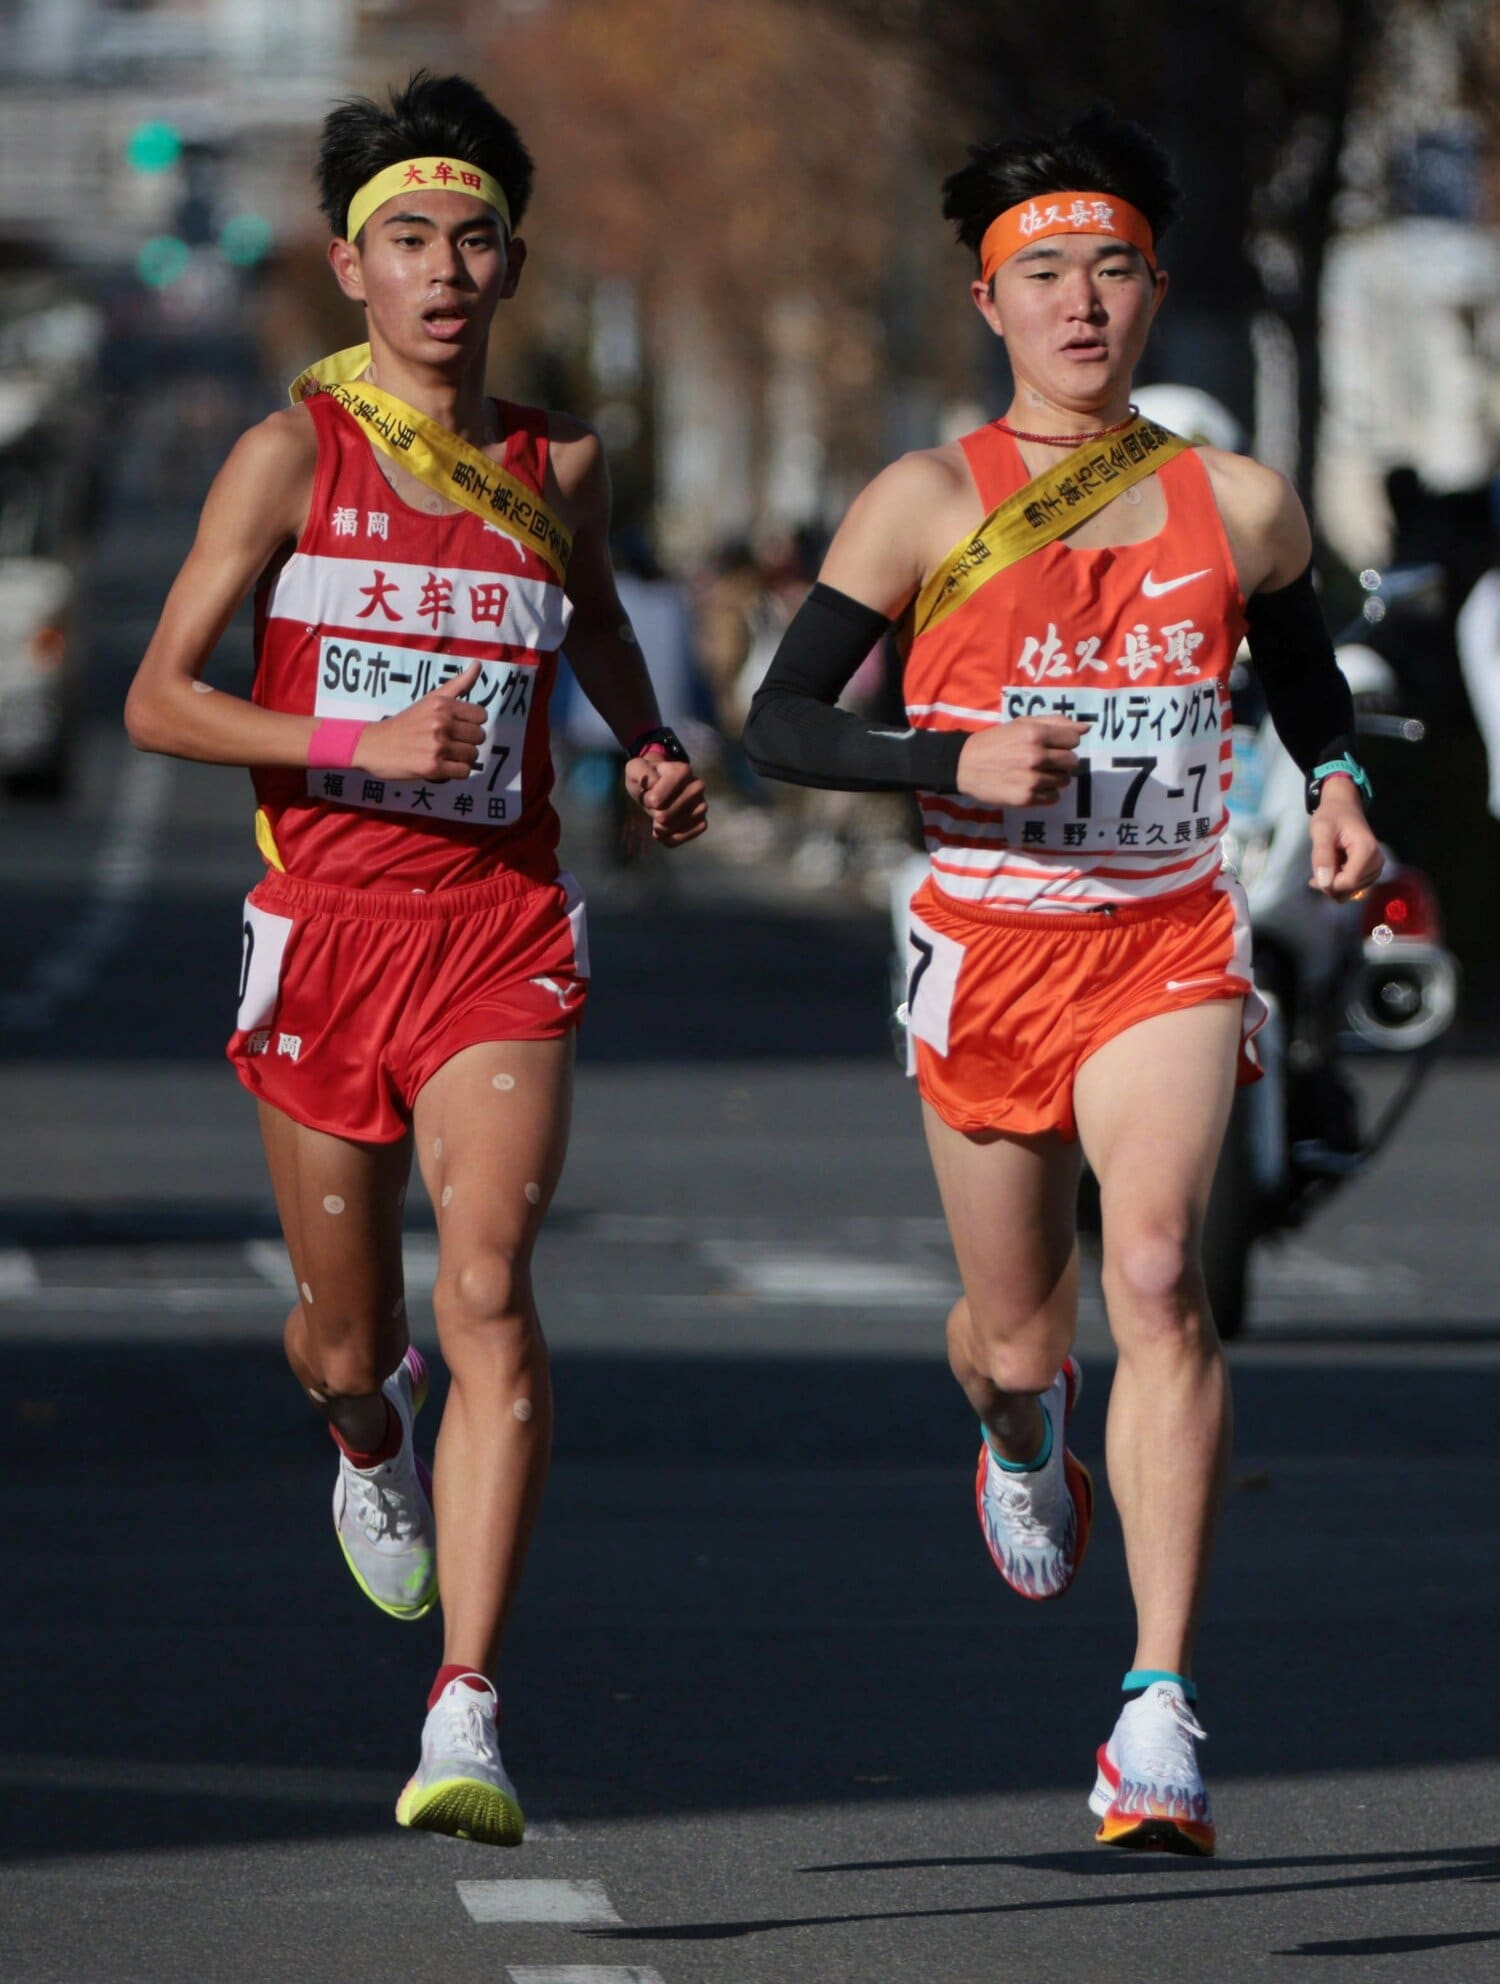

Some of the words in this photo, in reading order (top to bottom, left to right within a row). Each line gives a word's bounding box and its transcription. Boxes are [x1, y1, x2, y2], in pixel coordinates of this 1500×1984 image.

[400, 161, 482, 191] 大牟田
[1018, 199, 1115, 236] 佐久長聖
[331, 505, 390, 541] 福岡
[355, 569, 509, 631] 大牟田
[1016, 619, 1204, 683] 佐久長聖
[323, 772, 507, 820] 福岡・大牟田
